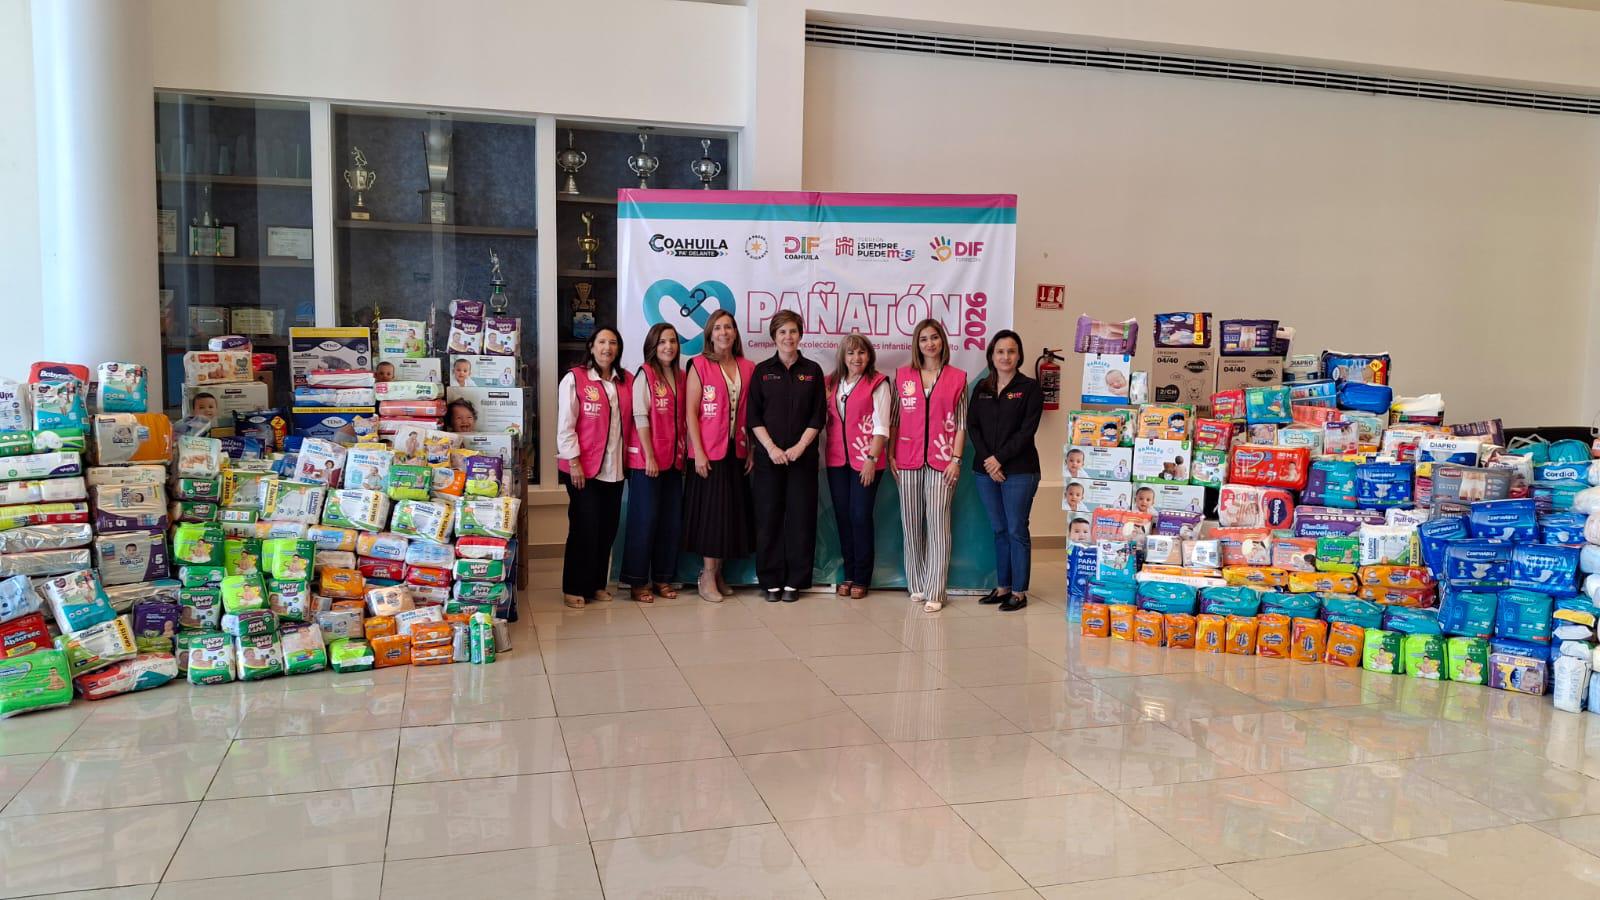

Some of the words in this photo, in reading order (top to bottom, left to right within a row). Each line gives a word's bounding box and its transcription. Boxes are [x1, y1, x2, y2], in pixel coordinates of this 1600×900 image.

[649, 234, 729, 253] COAHUILA
[783, 236, 821, 255] DIF
[857, 249, 887, 258] PUEDE
[955, 241, 985, 257] DIF
[784, 254, 819, 262] COAHUILA
[963, 291, 988, 352] 2026
[881, 342, 912, 352] infantile
[1156, 356, 1179, 365] 04/40
[1223, 365, 1247, 374] 04/40
[583, 402, 602, 411] DIF
[901, 397, 917, 407] DIF
[703, 403, 718, 412] DIF
[1429, 441, 1457, 449] DIAPRO
[370, 501, 379, 522] GRATIS
[1272, 499, 1281, 525] Babysec
[438, 521, 447, 539] GRATIS
[1300, 528, 1346, 538] Suavelastic
[155, 553, 164, 565] 5
[1077, 557, 1097, 566] PAÑA
[279, 582, 300, 590] HAPPY
[191, 594, 214, 602] HAPPY
[120, 626, 131, 648] GRATIS
[202, 637, 224, 645] HAPPY
[251, 634, 273, 642] HAPPY
